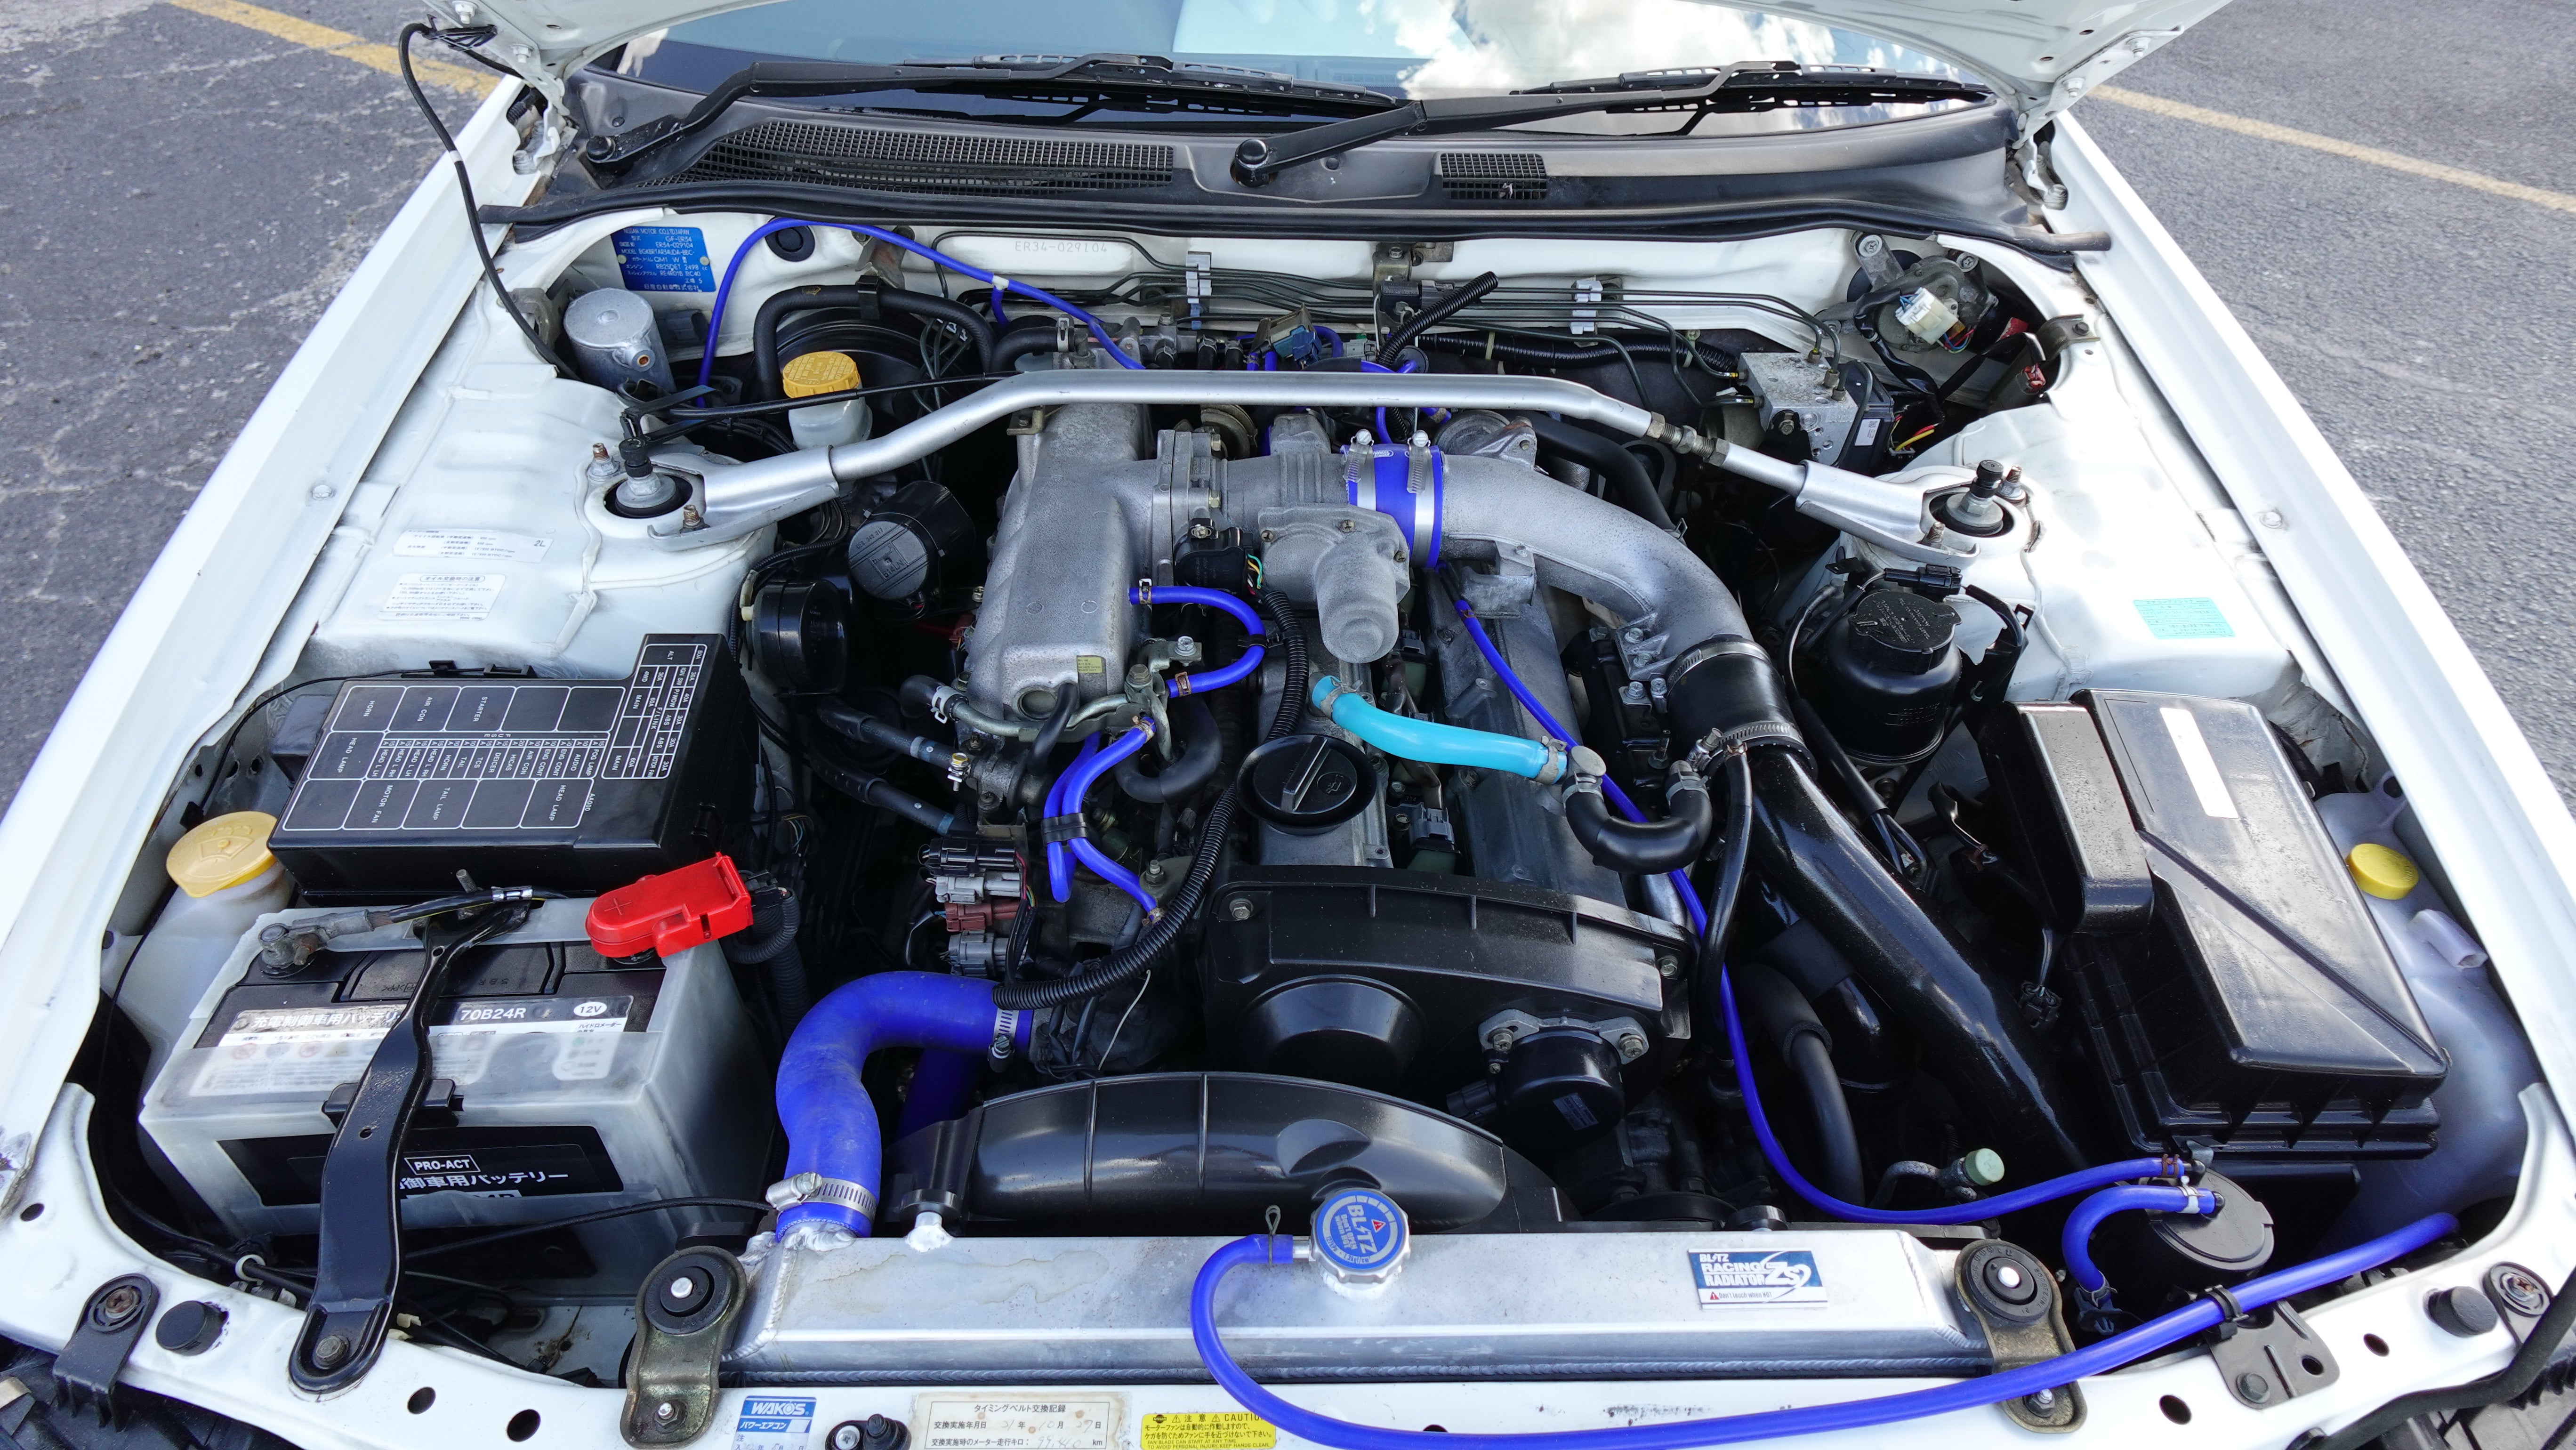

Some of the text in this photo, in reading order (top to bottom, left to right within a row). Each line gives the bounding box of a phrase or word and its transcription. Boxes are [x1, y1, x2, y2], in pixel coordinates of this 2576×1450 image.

[1015, 241, 1108, 253] ER34-029104
[641, 670, 664, 683] 4WD 30A
[677, 677, 684, 686] SW
[363, 700, 376, 717] HORN
[632, 694, 643, 709] MAIN
[417, 696, 433, 722] AIR CON
[472, 696, 488, 722] STARTER
[663, 714, 684, 726] ABS 30A
[656, 737, 676, 749] ABS 30A
[337, 738, 358, 773] HEAD LAMP
[378, 749, 389, 763] HEAD
[394, 749, 406, 763] HEAD
[411, 749, 422, 763] HEAD
[427, 749, 438, 763] HEAD
[440, 754, 452, 771] HORN
[457, 756, 467, 769] TAIL
[474, 757, 483, 768] TCS
[488, 752, 501, 773] DEICER
[520, 750, 534, 775] AIR CON
[570, 753, 581, 772] AUDIO
[585, 749, 600, 776] FOG LAMP
[505, 754, 517, 772] HICAS
[536, 749, 551, 777] ENG CONT
[552, 749, 567, 777] ENG CONT
[612, 755, 636, 771] MAIN 60A
[650, 755, 659, 769] MOTOR
[661, 761, 669, 772] 30A
[388, 769, 396, 777] RH
[421, 769, 429, 777] RH
[371, 784, 394, 824] MOTOR FAN
[432, 787, 451, 821] TAIL LAMP
[548, 784, 567, 822] HEAD LAMP
[460, 1007, 526, 1021] 70B24R
[579, 1005, 602, 1014] 12V
[251, 1011, 401, 1028] 充電制御車用バッテリ
[414, 1159, 470, 1171] PRO-ACT
[400, 1171, 568, 1190] 御車用バッテリー
[1347, 1204, 1378, 1254] BLITZ
[1699, 1253, 1729, 1262] BLITZ
[1700, 1262, 1763, 1272] RACING
[1704, 1274, 1765, 1286] RADIATOR
[974, 1404, 1066, 1413] タイミングベルト交換記録
[1224, 1413, 1262, 1421] CAUTIO
[740, 1420, 787, 1430] パワーエアコン
[934, 1421, 987, 1429] 交換実施年月日
[1018, 1421, 1026, 1429] 年
[1145, 1423, 1250, 1431] モーターファンは自動的に作動しますので、
[1145, 1431, 1272, 1440] ケガを防ぐためファンに手を近づけないで下さい。
